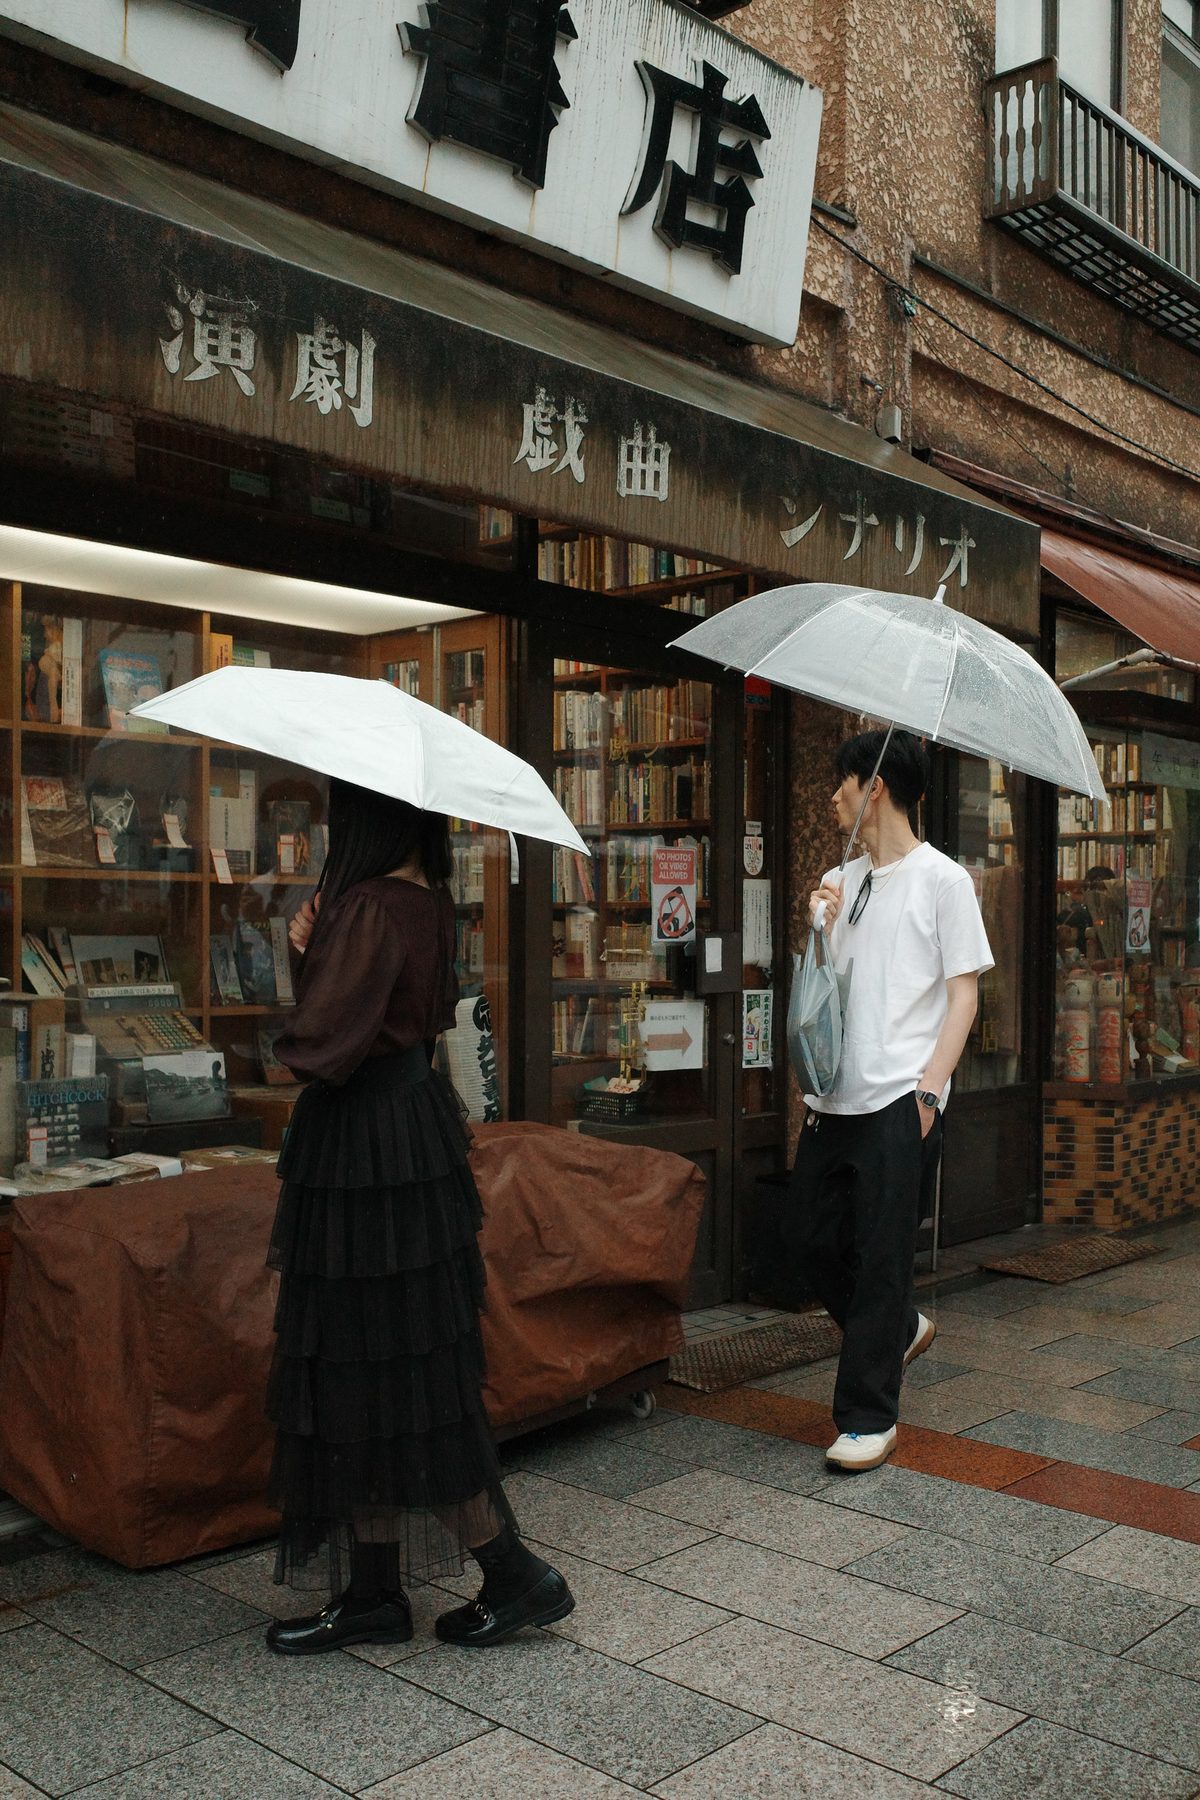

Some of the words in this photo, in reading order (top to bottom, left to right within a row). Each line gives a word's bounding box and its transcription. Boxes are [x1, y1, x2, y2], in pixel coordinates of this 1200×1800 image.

[194, 0, 772, 276] 書店
[159, 285, 377, 428] 演劇
[513, 386, 672, 502] 戯曲
[656, 852, 666, 861] NO
[667, 853, 692, 862] PHOTOS
[659, 861, 669, 870] OR
[669, 862, 688, 871] VIDEO
[658, 871, 689, 880] ALLOWED
[27, 1089, 105, 1106] HITCHCOCK
